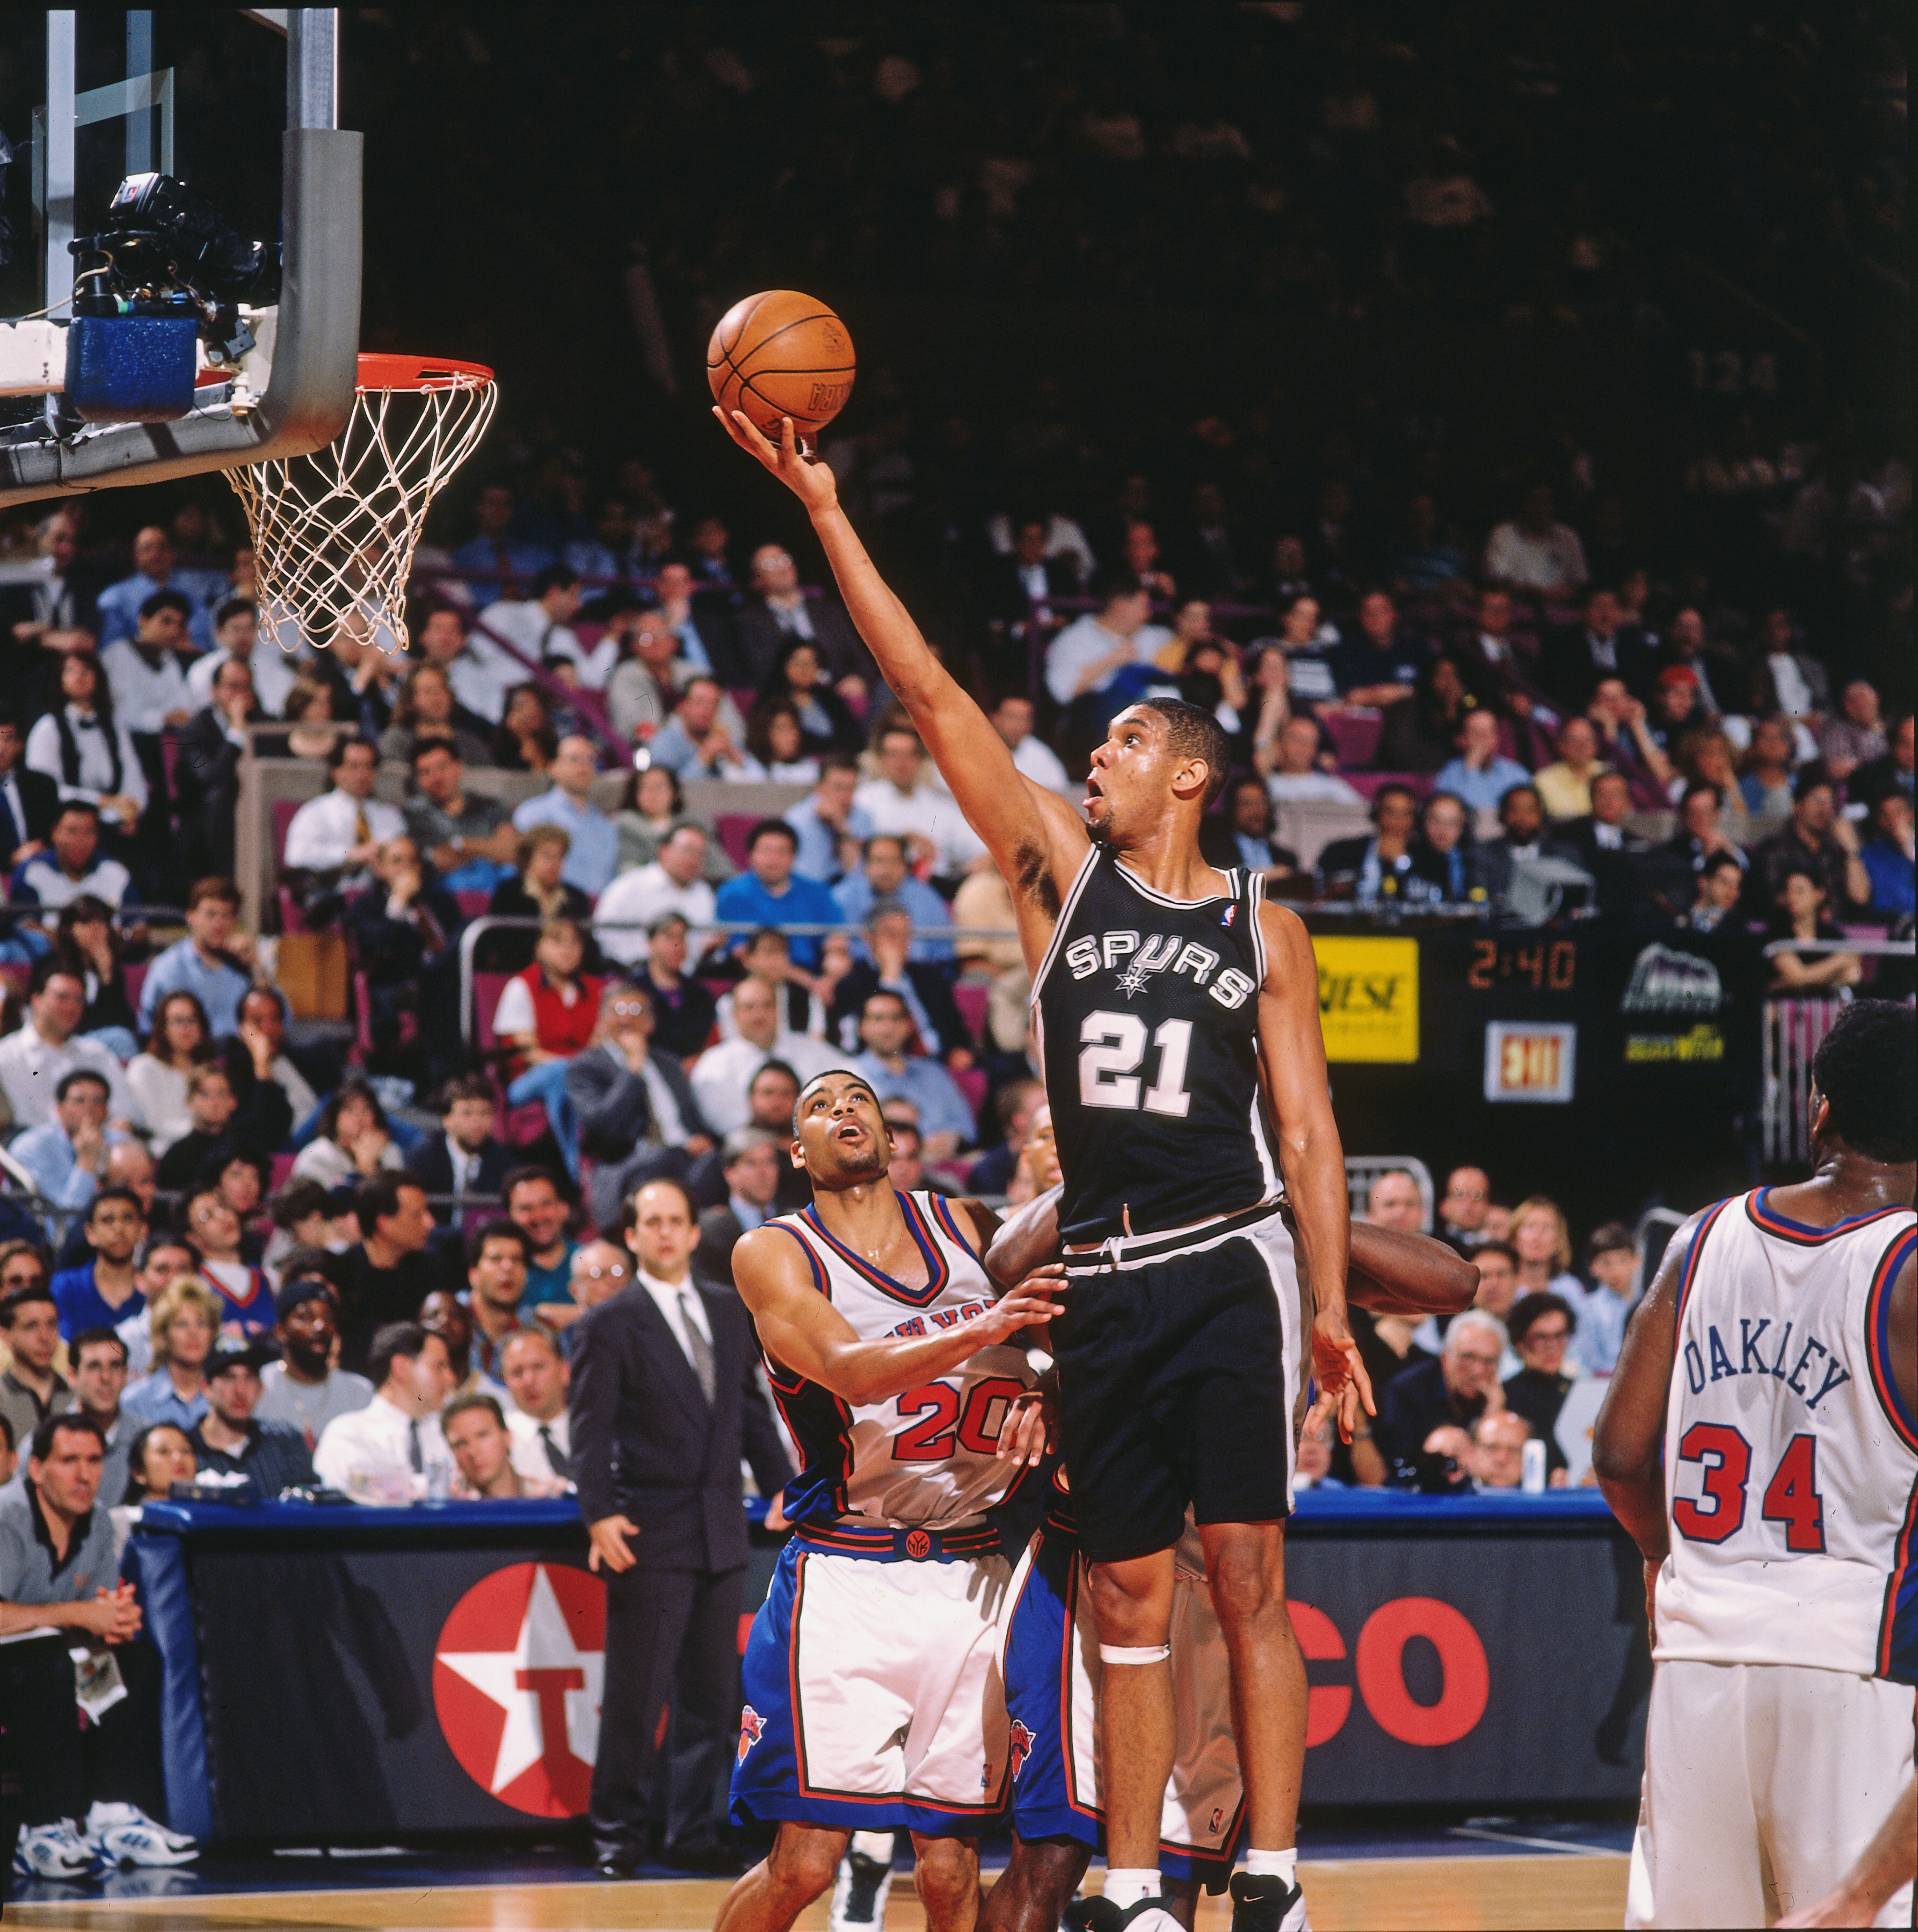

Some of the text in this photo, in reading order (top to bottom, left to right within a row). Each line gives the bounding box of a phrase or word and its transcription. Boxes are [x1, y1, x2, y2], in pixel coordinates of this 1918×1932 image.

[1688, 350, 1778, 394] 124
[1065, 930, 1255, 1009] SPURS
[1467, 939, 1576, 990] 2:40
[1079, 1009, 1193, 1117] 21
[1684, 1319, 1851, 1410] OAKLEY
[891, 1376, 1029, 1461] 20
[1673, 1421, 1826, 1553] 34
